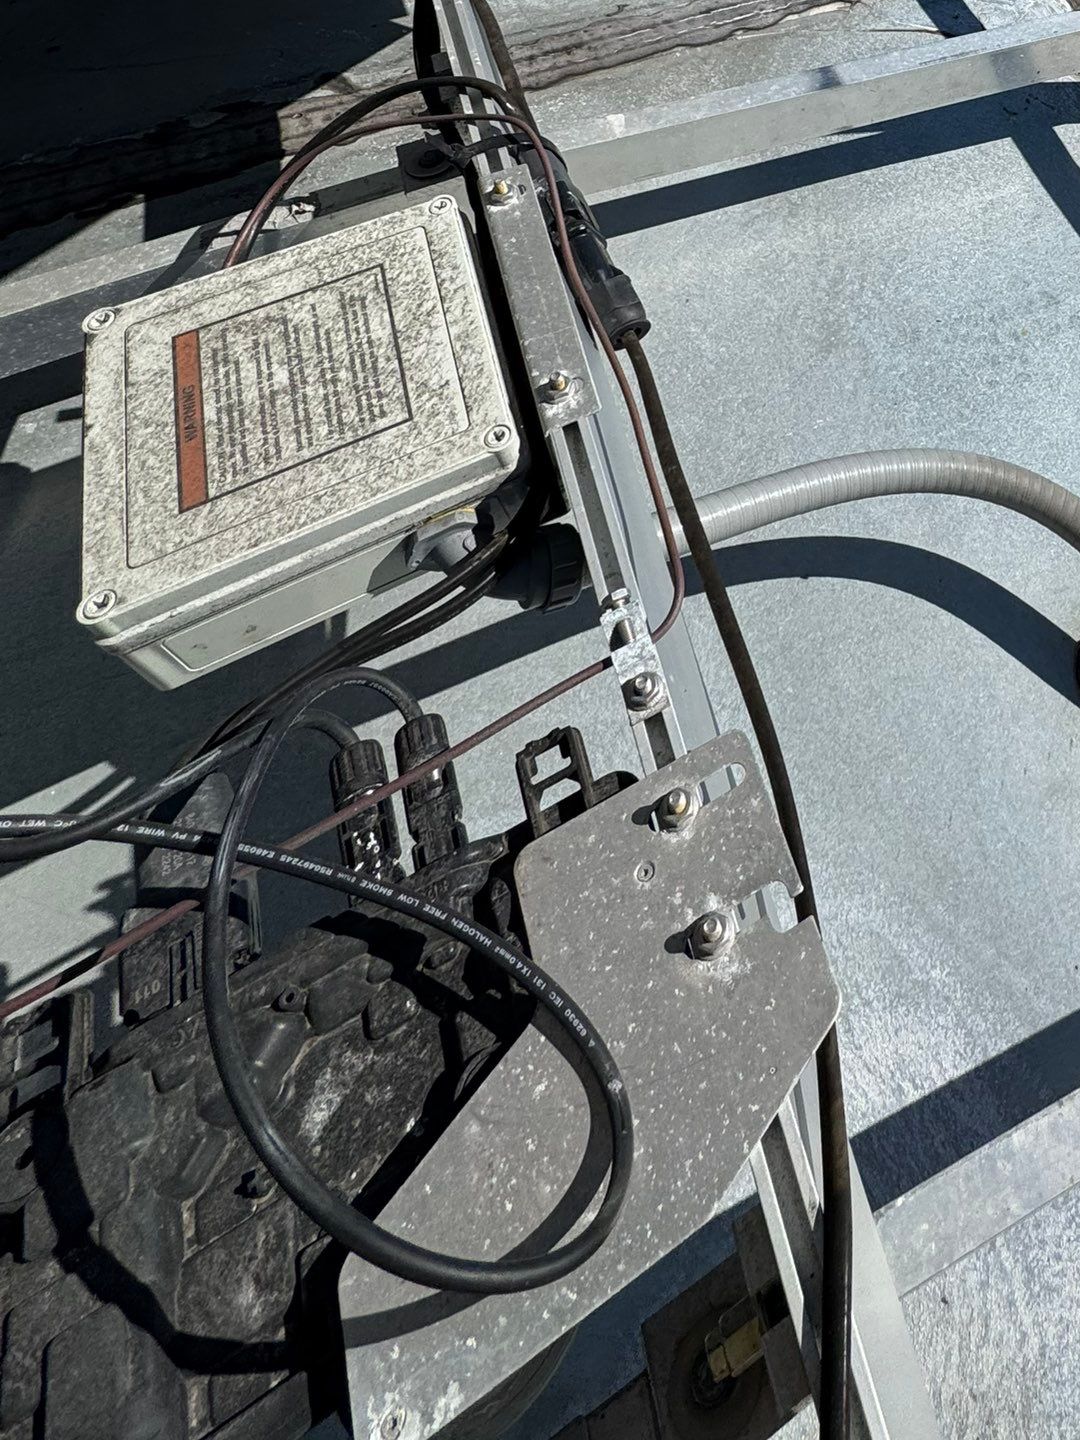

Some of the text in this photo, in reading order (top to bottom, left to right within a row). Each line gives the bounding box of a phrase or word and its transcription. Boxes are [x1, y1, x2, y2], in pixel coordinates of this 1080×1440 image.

[182, 383, 197, 443] WARNING
[18, 819, 47, 827] WET
[136, 825, 164, 838] WIRE
[171, 830, 188, 841] PV
[359, 878, 394, 896] SMOKE
[397, 892, 420, 906] LOW
[423, 903, 448, 919] FREE
[449, 917, 492, 947] HALOGEN
[547, 990, 564, 1008] IEC
[563, 1007, 588, 1038] 62930
